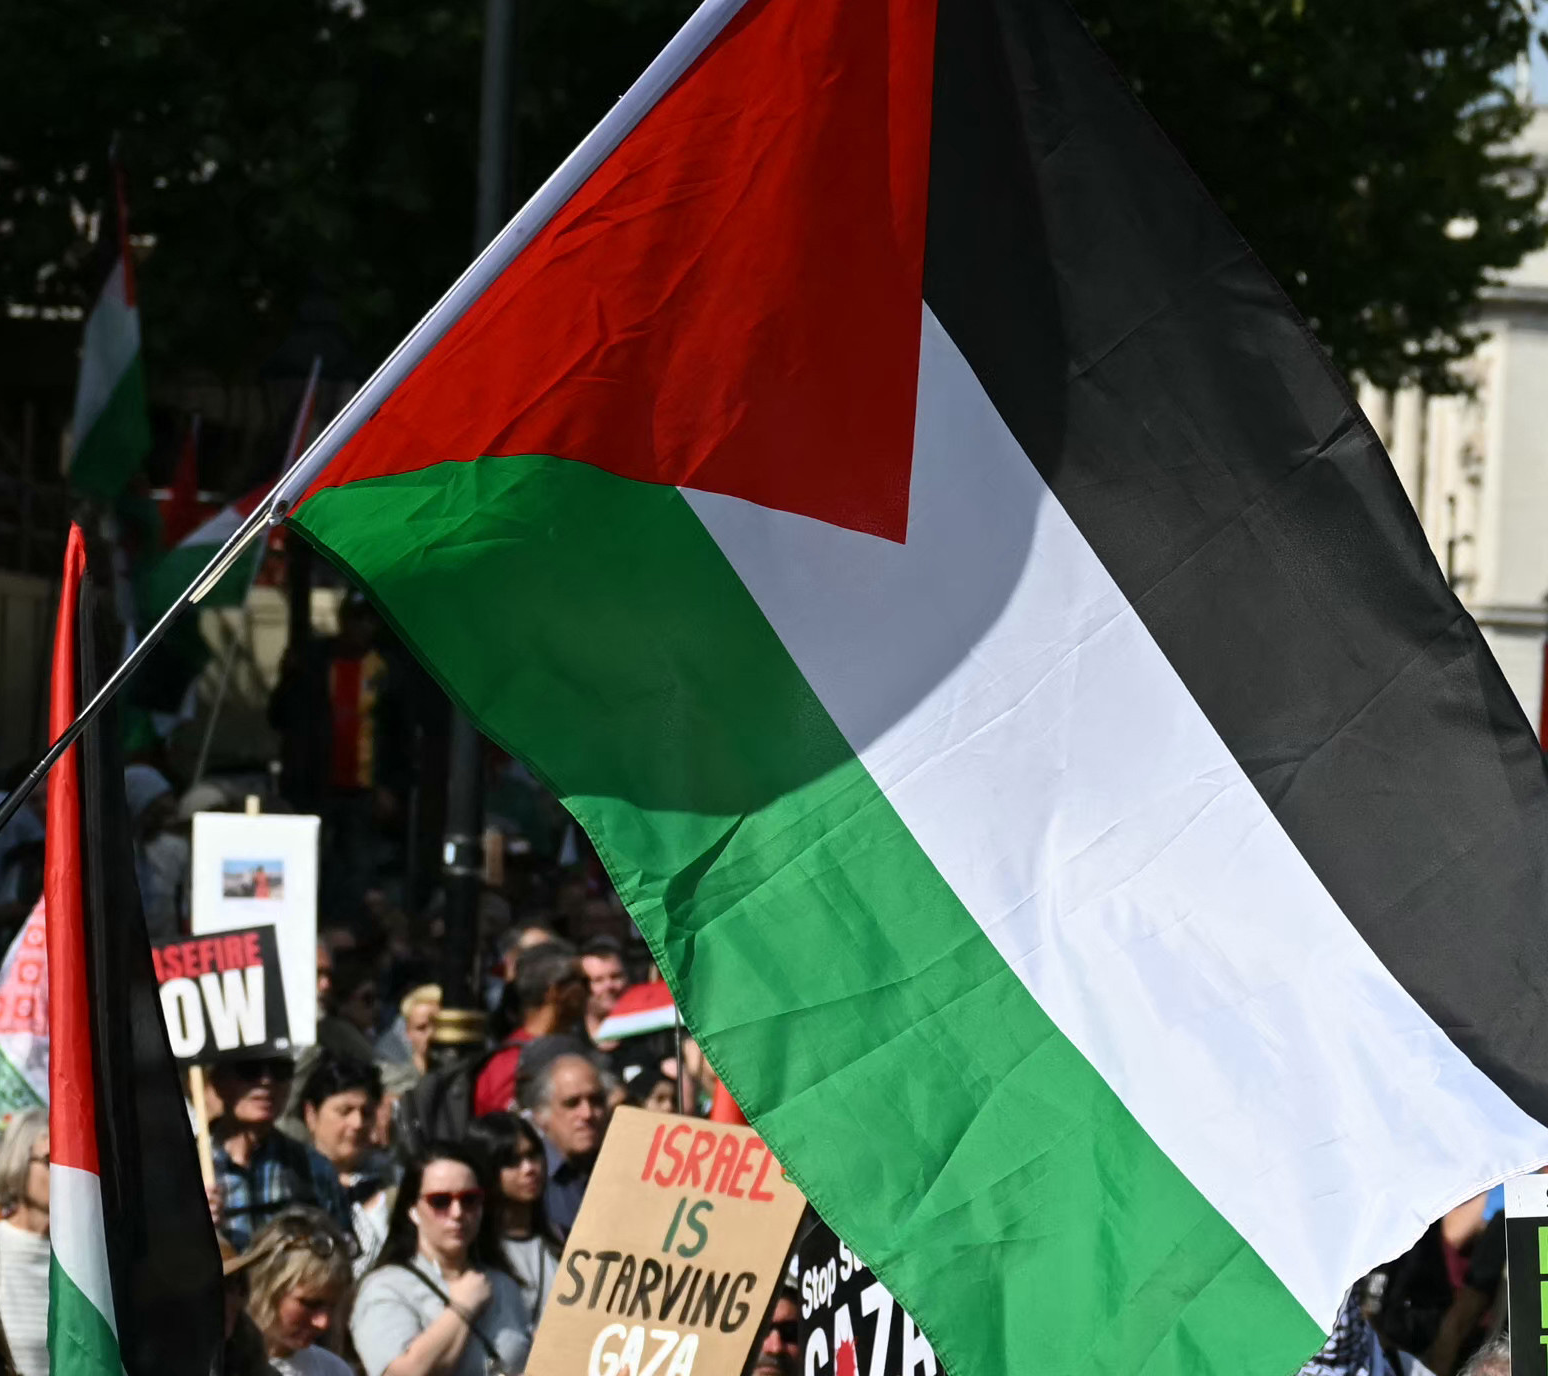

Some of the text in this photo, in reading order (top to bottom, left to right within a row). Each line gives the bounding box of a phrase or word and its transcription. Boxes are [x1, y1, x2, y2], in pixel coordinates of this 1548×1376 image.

[152, 931, 264, 985] SEFIRE
[159, 966, 267, 1058] OW
[641, 1123, 775, 1203] ISRAEL
[661, 1196, 714, 1259] IS
[556, 1249, 758, 1334] STARVING
[801, 1256, 837, 1321] Stop
